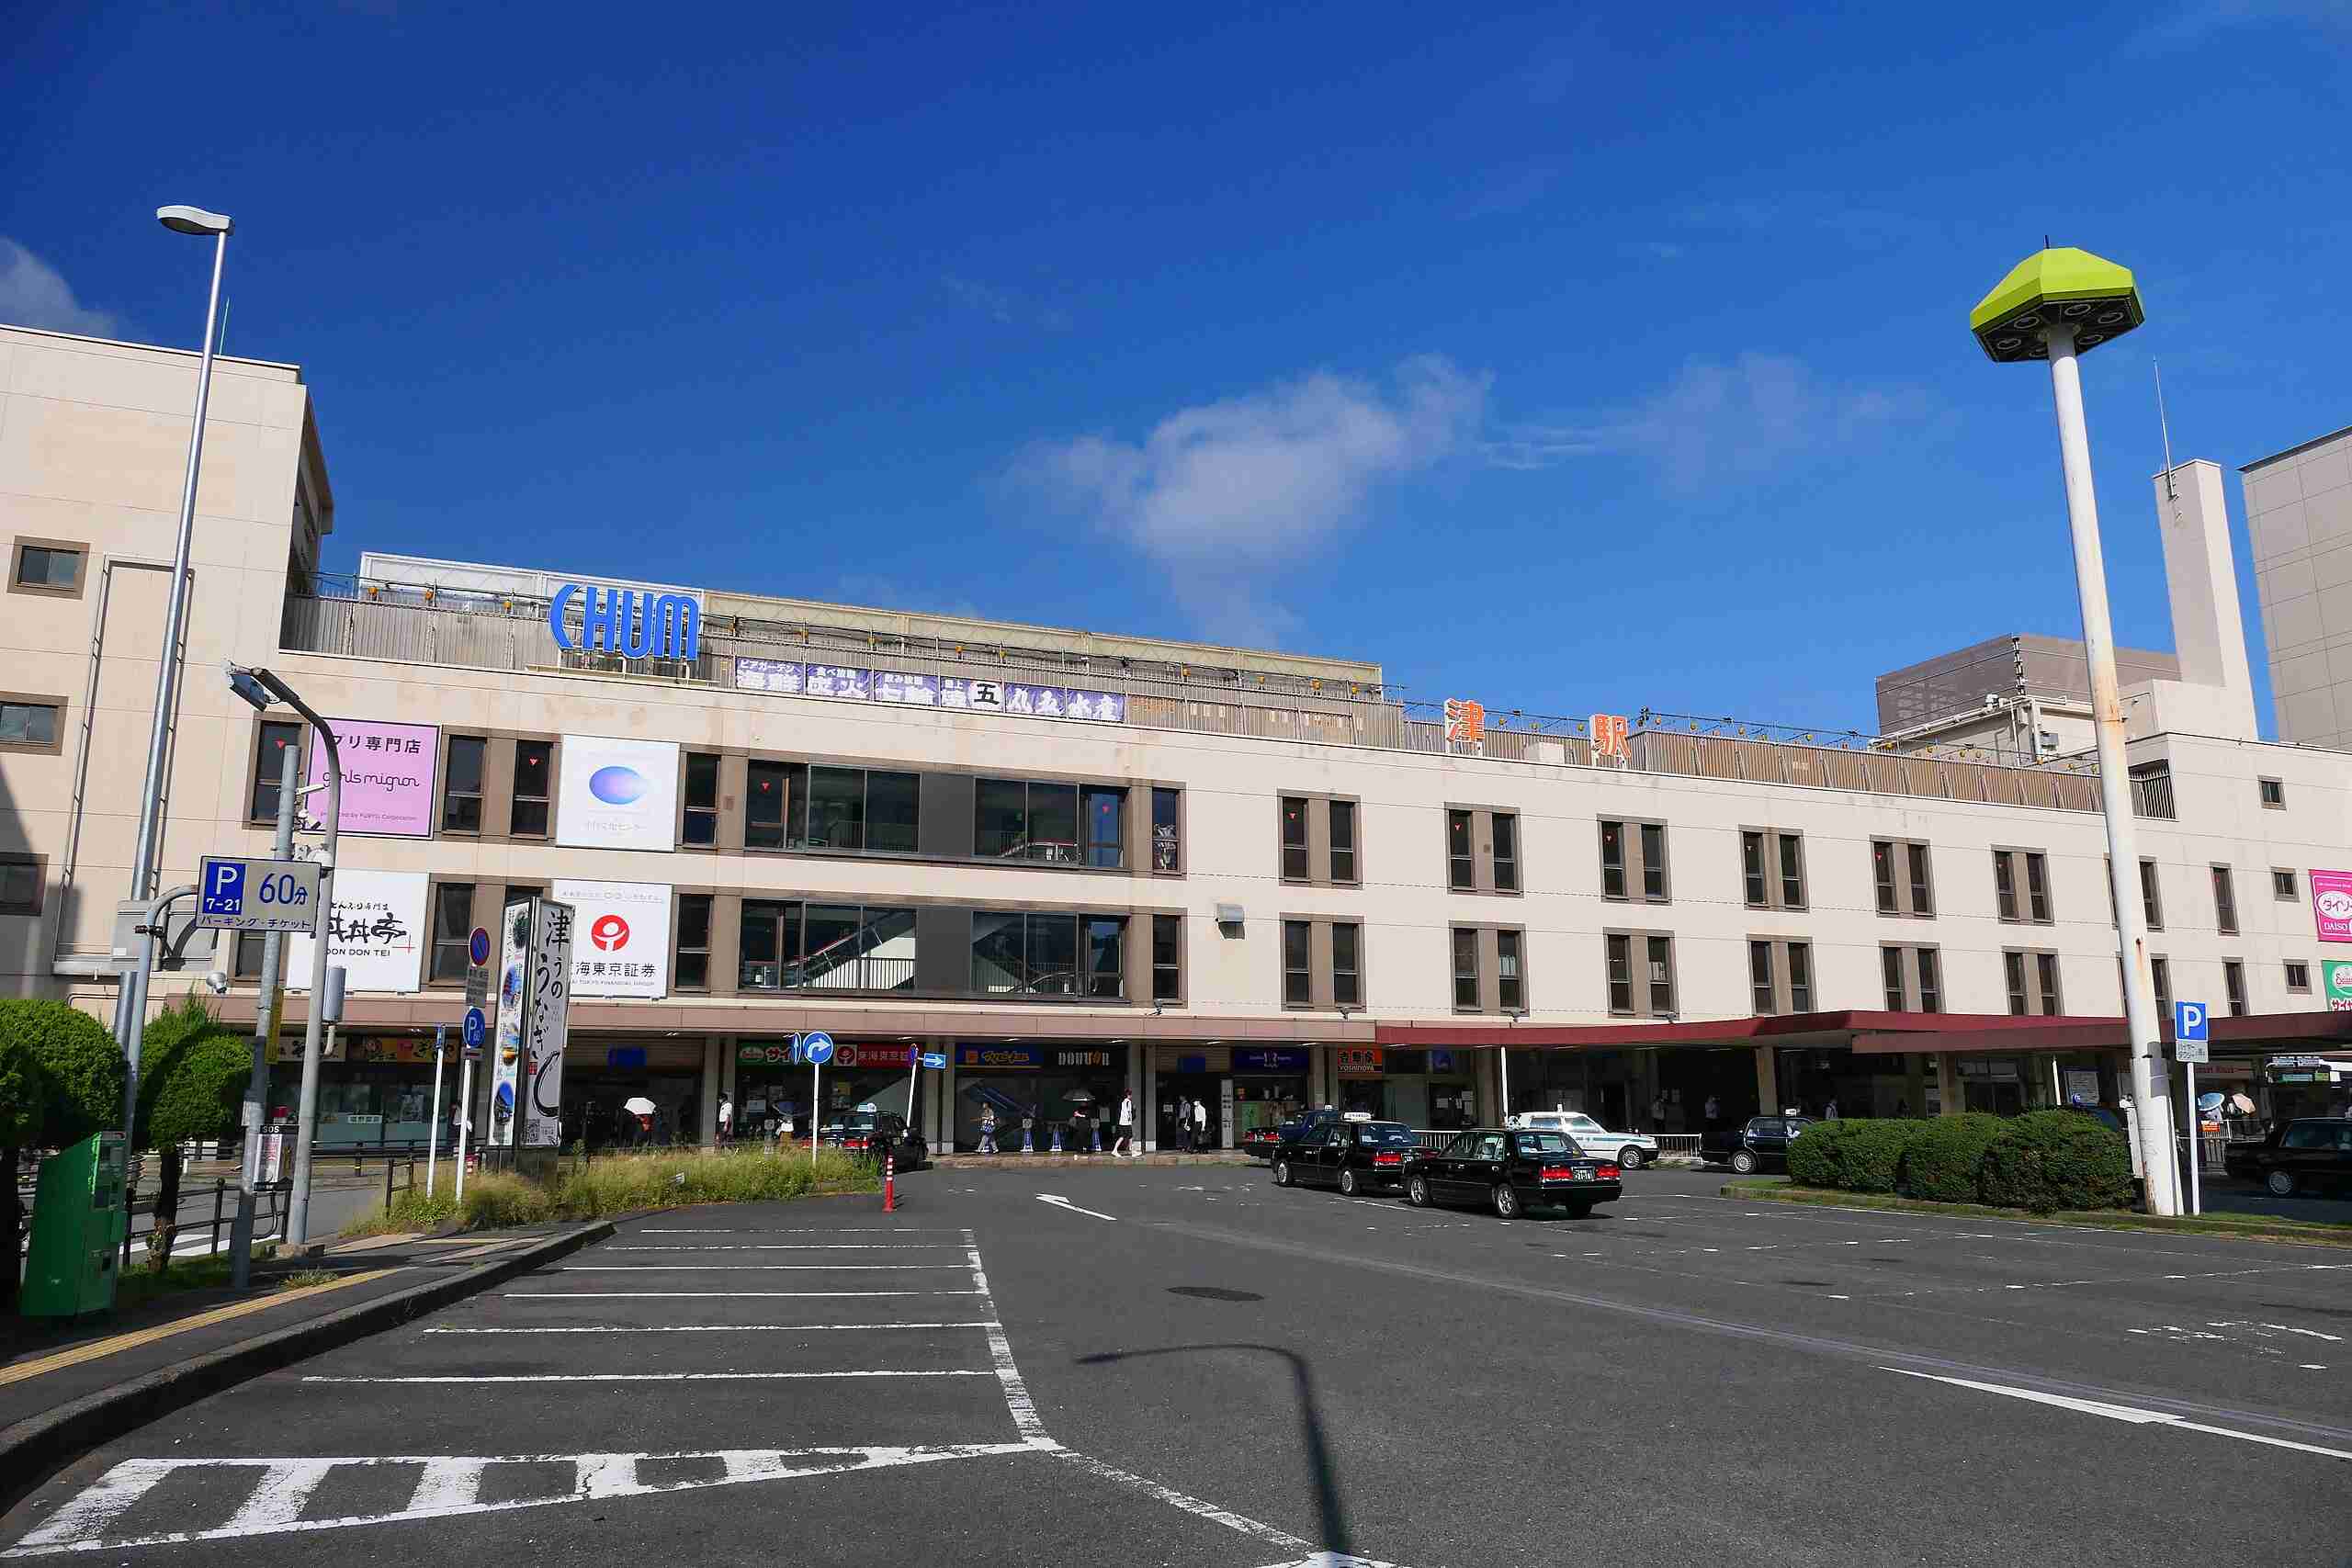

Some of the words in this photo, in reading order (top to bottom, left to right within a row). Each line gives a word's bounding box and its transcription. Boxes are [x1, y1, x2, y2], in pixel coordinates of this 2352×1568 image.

[550, 584, 700, 660] CHUM
[740, 659, 796, 673] ビアガーデン
[216, 866, 238, 895] P
[259, 873, 309, 905] 60分
[206, 897, 240, 911] 7-21
[2322, 895, 2352, 912] ダイソ
[348, 948, 369, 956] DON
[571, 962, 656, 978] 海東京証券
[468, 1016, 478, 1041] P
[2183, 1005, 2201, 1036] P
